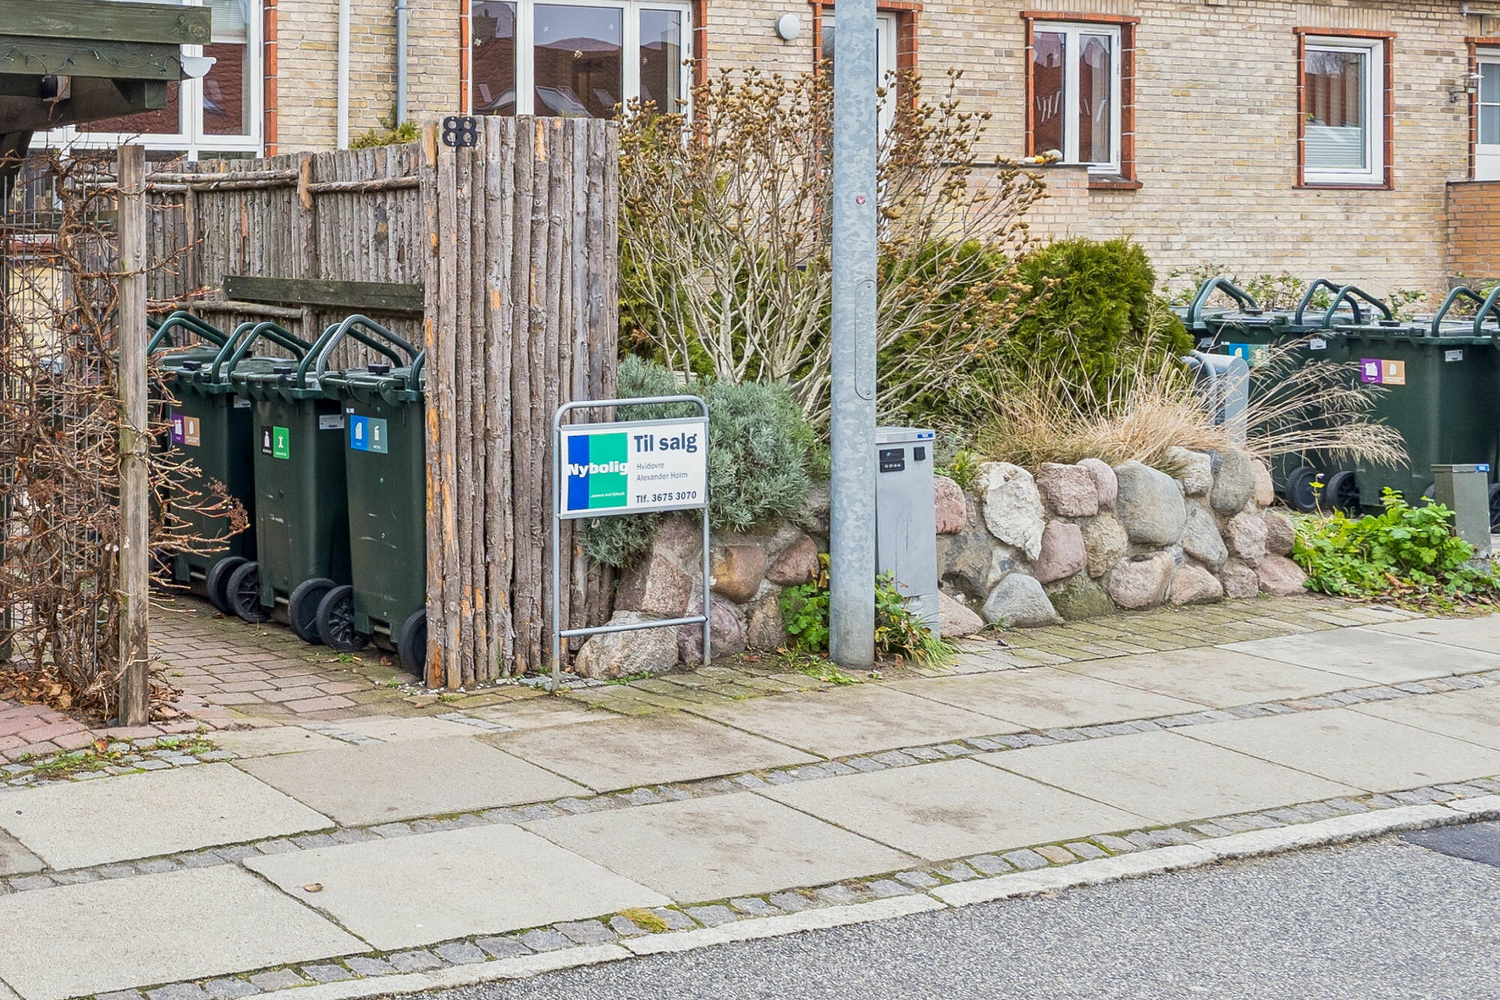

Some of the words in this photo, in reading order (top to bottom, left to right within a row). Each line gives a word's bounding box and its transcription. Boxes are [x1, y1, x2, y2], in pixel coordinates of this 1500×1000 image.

[442, 115, 478, 147] 88
[633, 434, 654, 453] Til
[659, 432, 698, 454] salg
[568, 460, 628, 478] Nybolig
[636, 462, 665, 470] Hvidovre
[636, 472, 669, 481] Alexander
[636, 494, 650, 503] Tlf.
[651, 492, 673, 502] 3675
[675, 490, 697, 501] 3070
